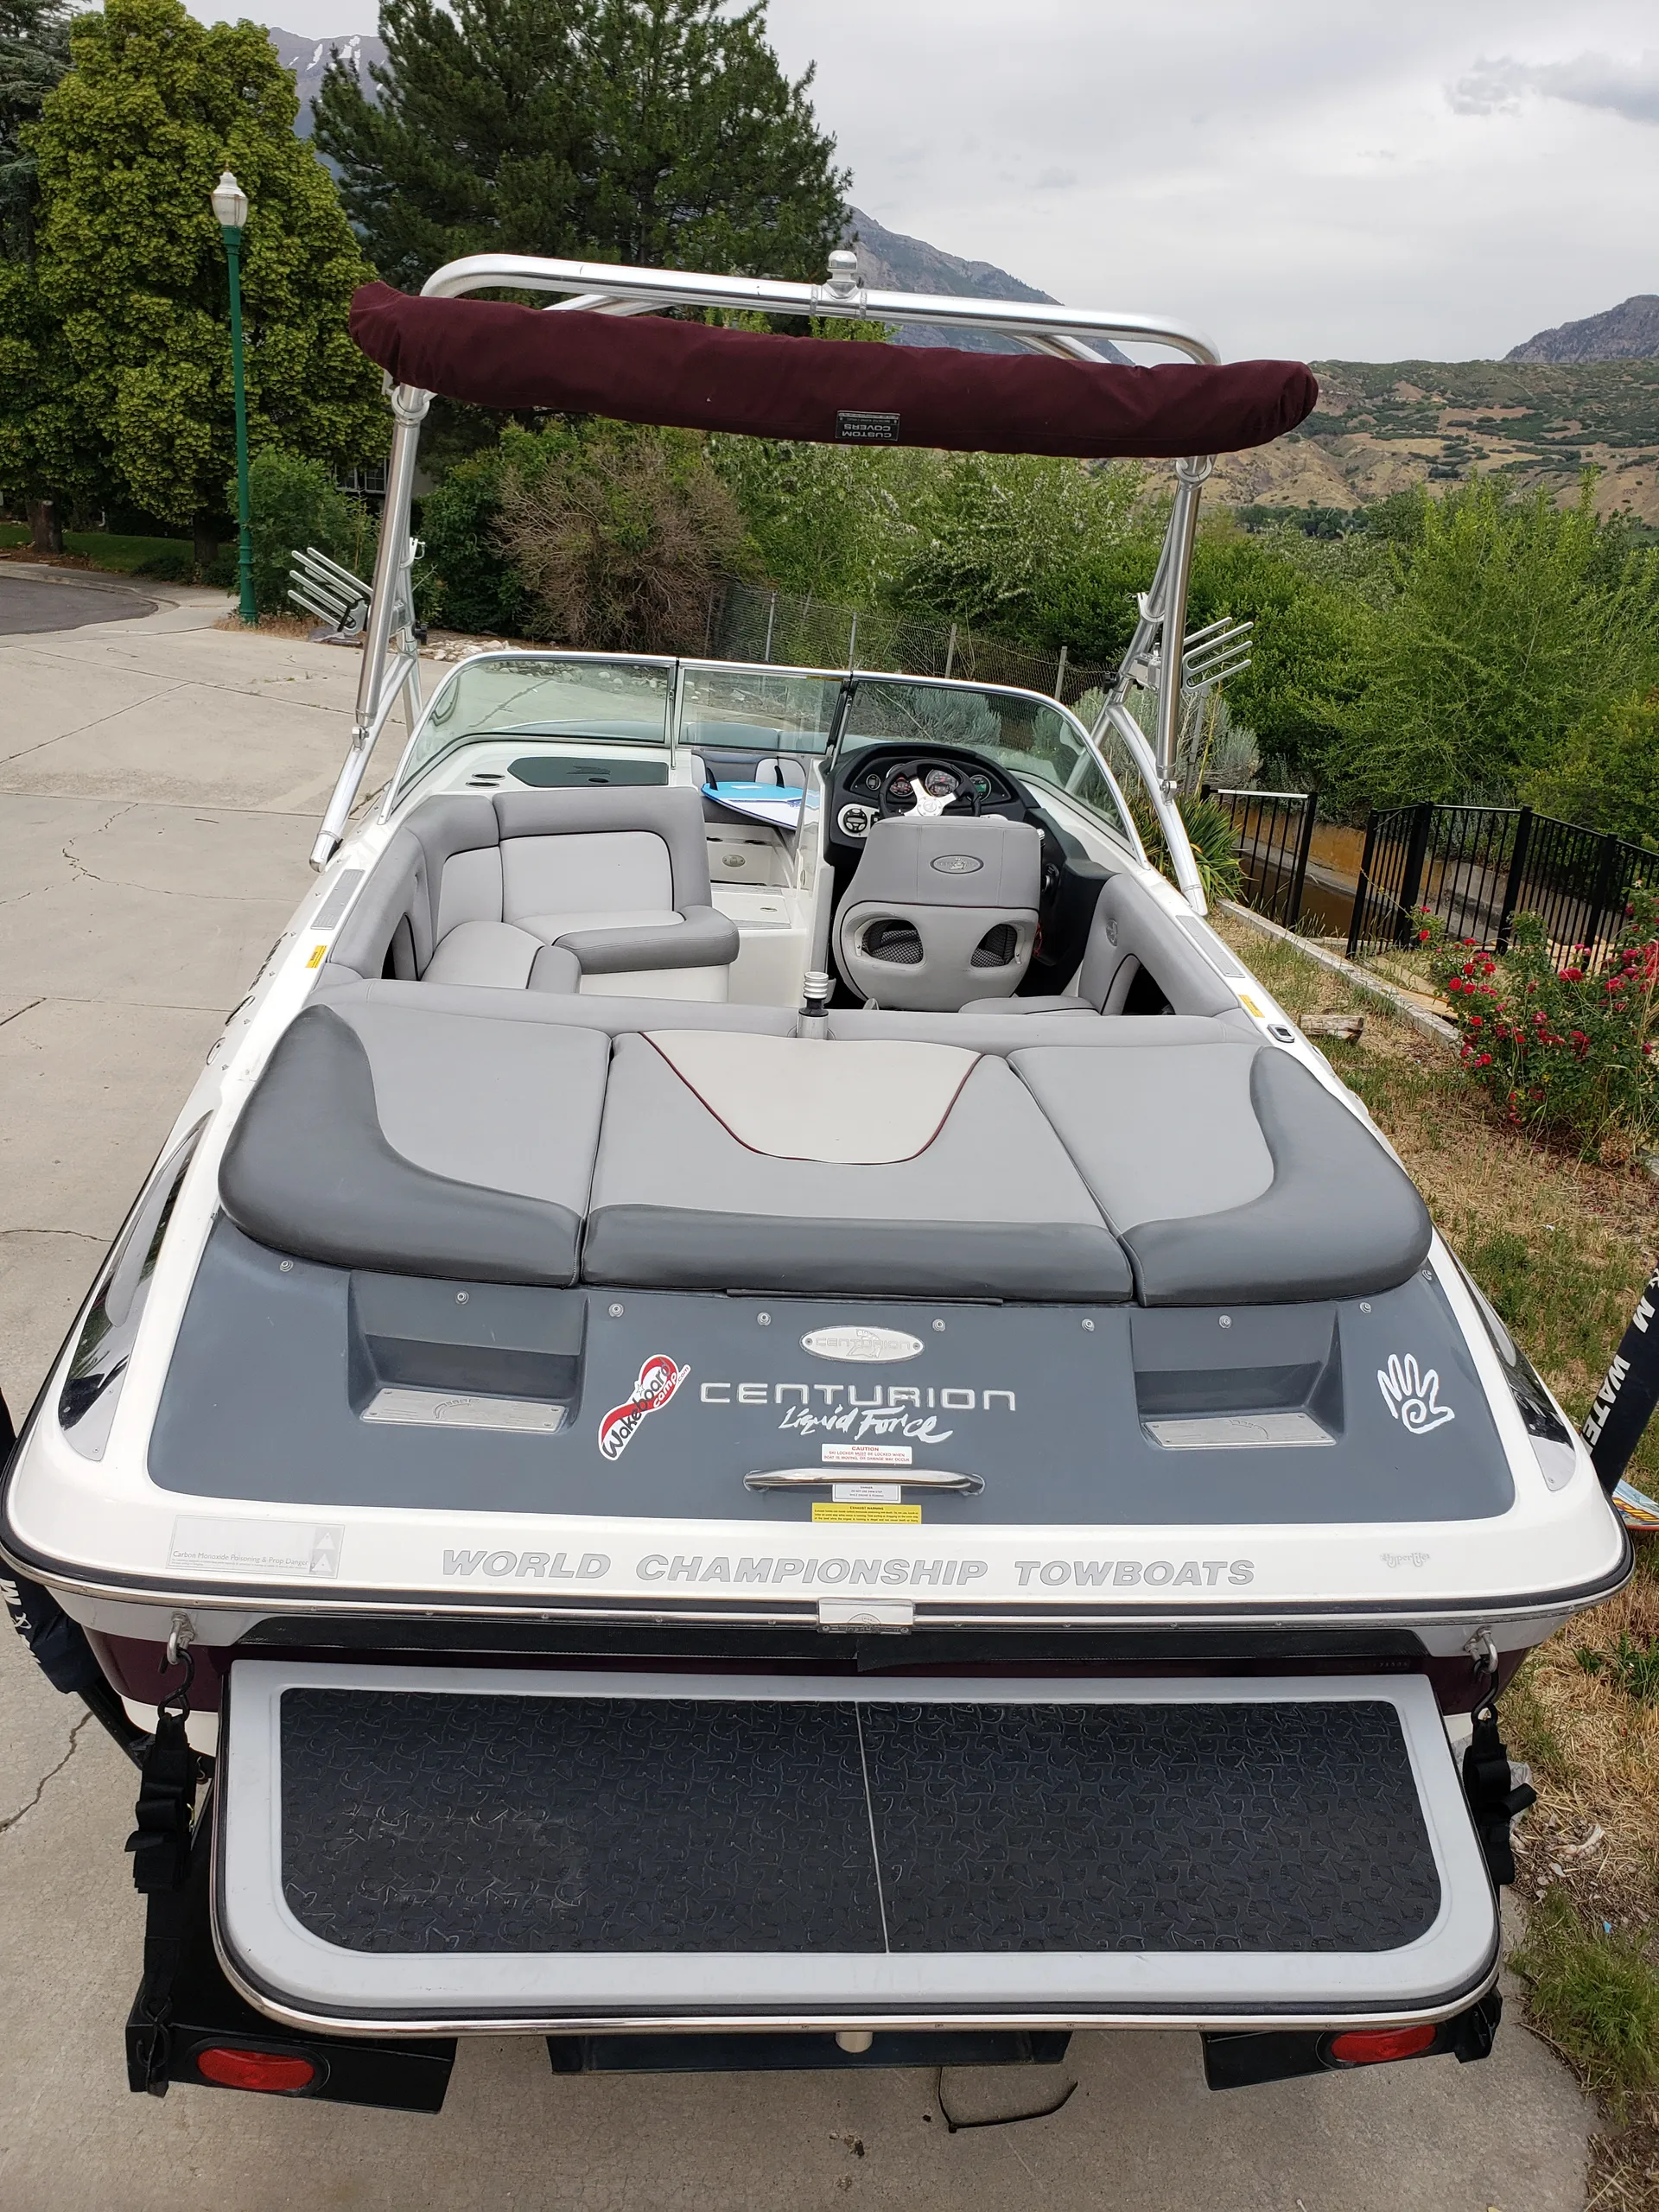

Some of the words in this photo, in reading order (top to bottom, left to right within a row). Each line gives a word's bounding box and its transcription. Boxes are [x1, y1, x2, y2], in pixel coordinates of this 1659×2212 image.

[700, 1382, 1016, 1411] CENTURION
[778, 1404, 859, 1435] Liquid
[854, 1405, 954, 1444] Force
[197, 1552, 229, 1560] Monoxide
[230, 1554, 260, 1564] Poisoning
[268, 1556, 284, 1566] Prop
[285, 1558, 308, 1567] Danger
[442, 1550, 611, 1580] WORLD
[636, 1554, 988, 1585] CHAMPIONSHIP
[1014, 1560, 1255, 1586] TOWBOATS
